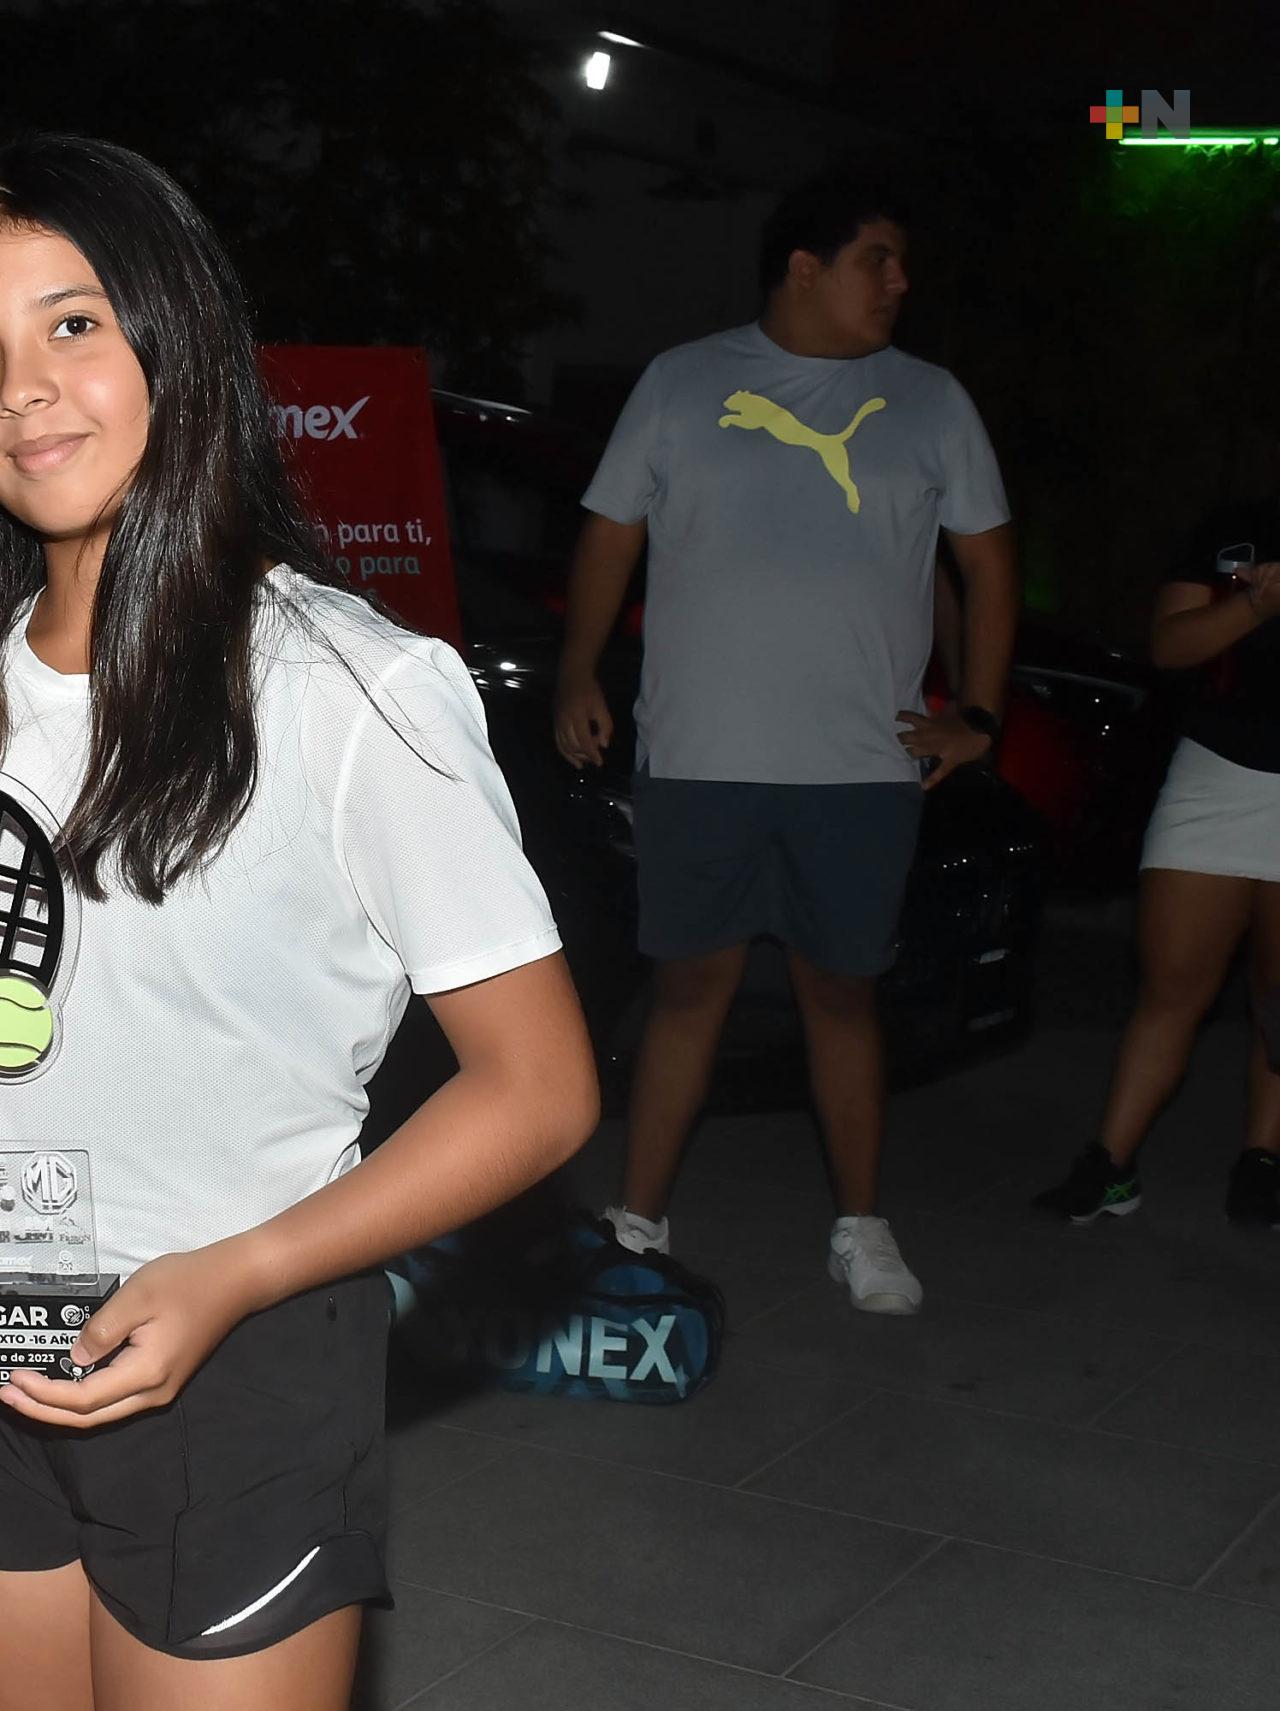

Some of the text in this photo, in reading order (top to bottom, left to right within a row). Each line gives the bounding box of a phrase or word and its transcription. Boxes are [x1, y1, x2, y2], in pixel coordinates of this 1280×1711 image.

[269, 396, 369, 440] mex
[337, 521, 400, 549] para
[405, 518, 432, 546] ti,
[360, 556, 420, 581] para
[24, 1154, 74, 1204] MG
[28, 1334, 47, 1345] -16
[9, 1352, 25, 1363] de
[27, 1353, 56, 1364] 2023
